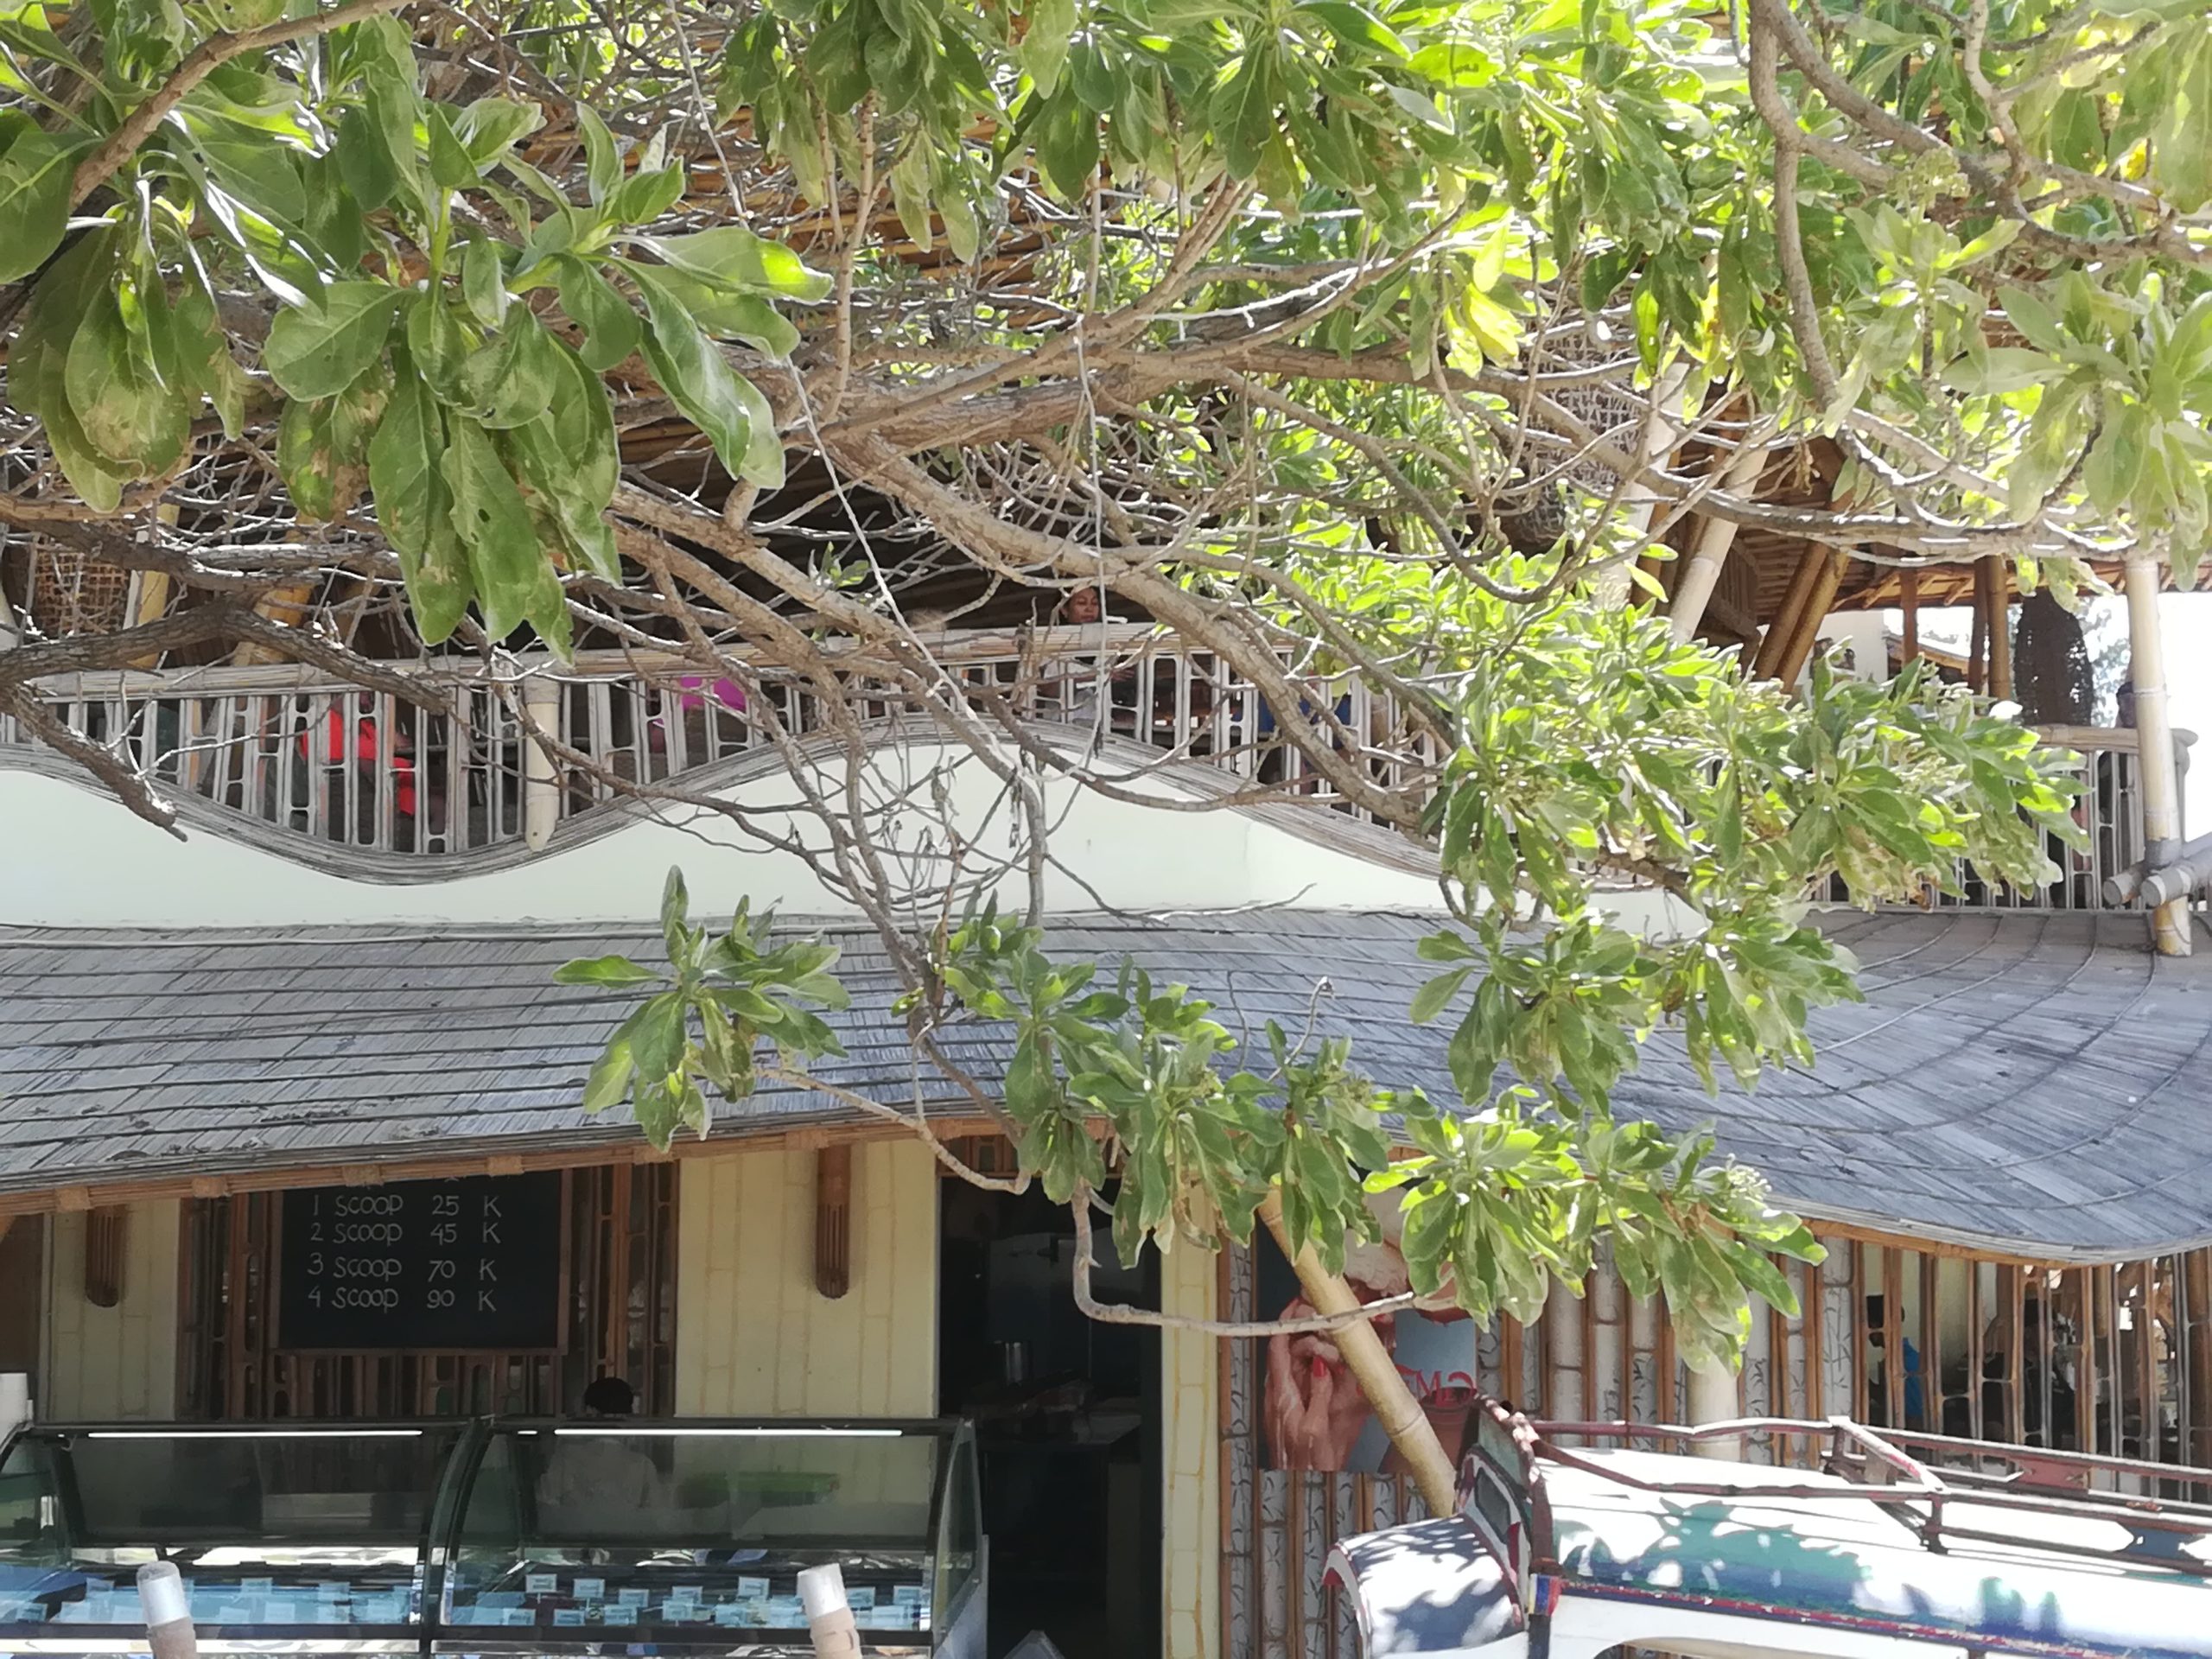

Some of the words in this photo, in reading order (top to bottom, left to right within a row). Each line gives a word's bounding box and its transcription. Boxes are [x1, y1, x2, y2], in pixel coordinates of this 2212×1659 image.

[313, 1194, 320, 1217] 1
[431, 1194, 460, 1217] 25
[483, 1195, 502, 1217] K
[310, 1222, 324, 1242] 2
[430, 1223, 457, 1246] 45
[483, 1222, 501, 1244] K
[307, 1252, 324, 1275] 3
[428, 1260, 456, 1282] 70
[479, 1258, 498, 1281] K
[307, 1286, 321, 1308] 4
[426, 1289, 455, 1309] 90
[478, 1289, 497, 1312] K
